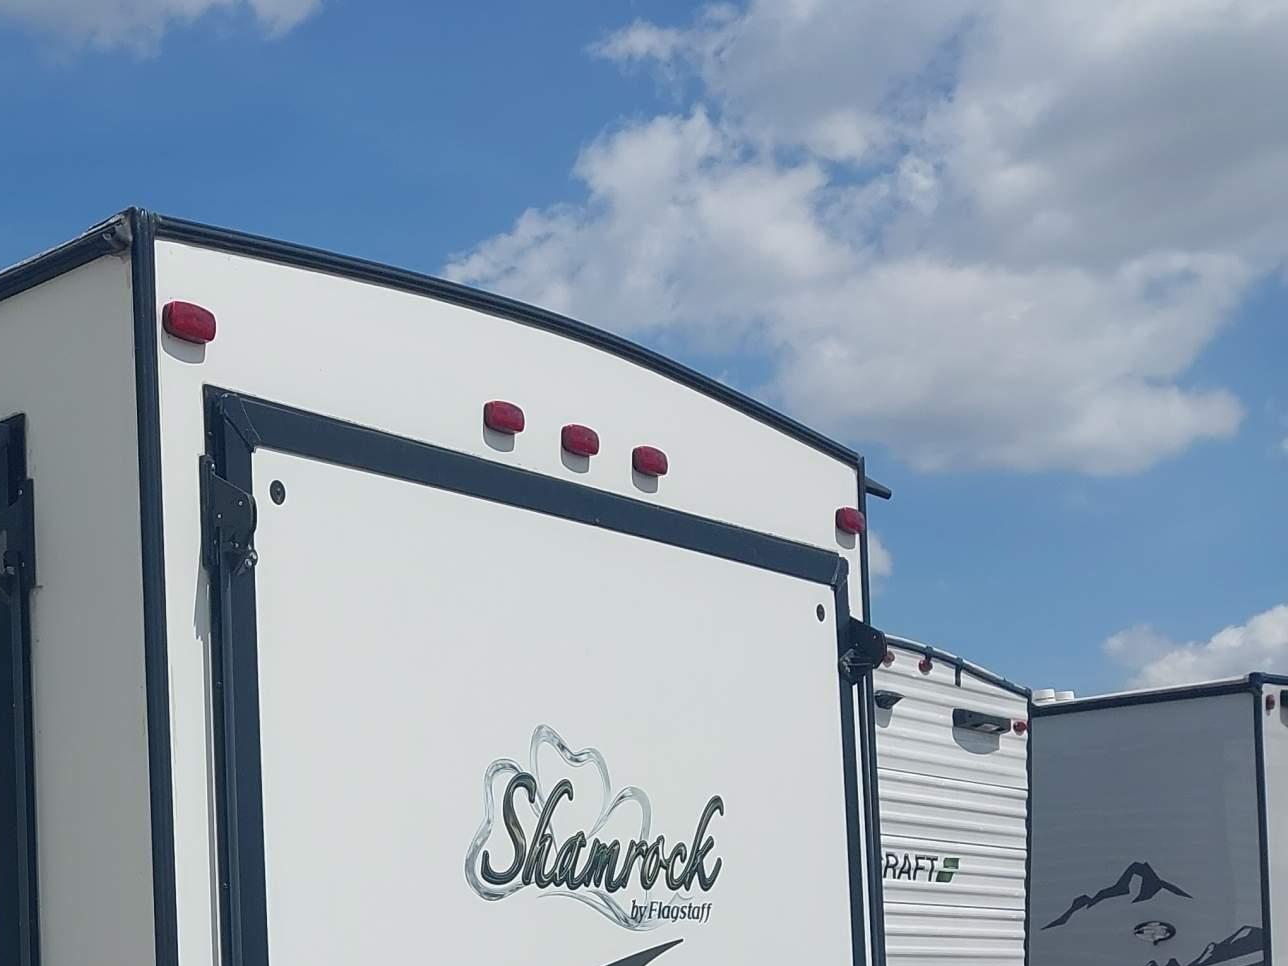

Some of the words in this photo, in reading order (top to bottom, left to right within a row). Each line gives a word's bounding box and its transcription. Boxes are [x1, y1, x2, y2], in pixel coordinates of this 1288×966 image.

[481, 771, 725, 894] Shamrock
[630, 899, 647, 921] by
[647, 900, 714, 924] Flagstaff
